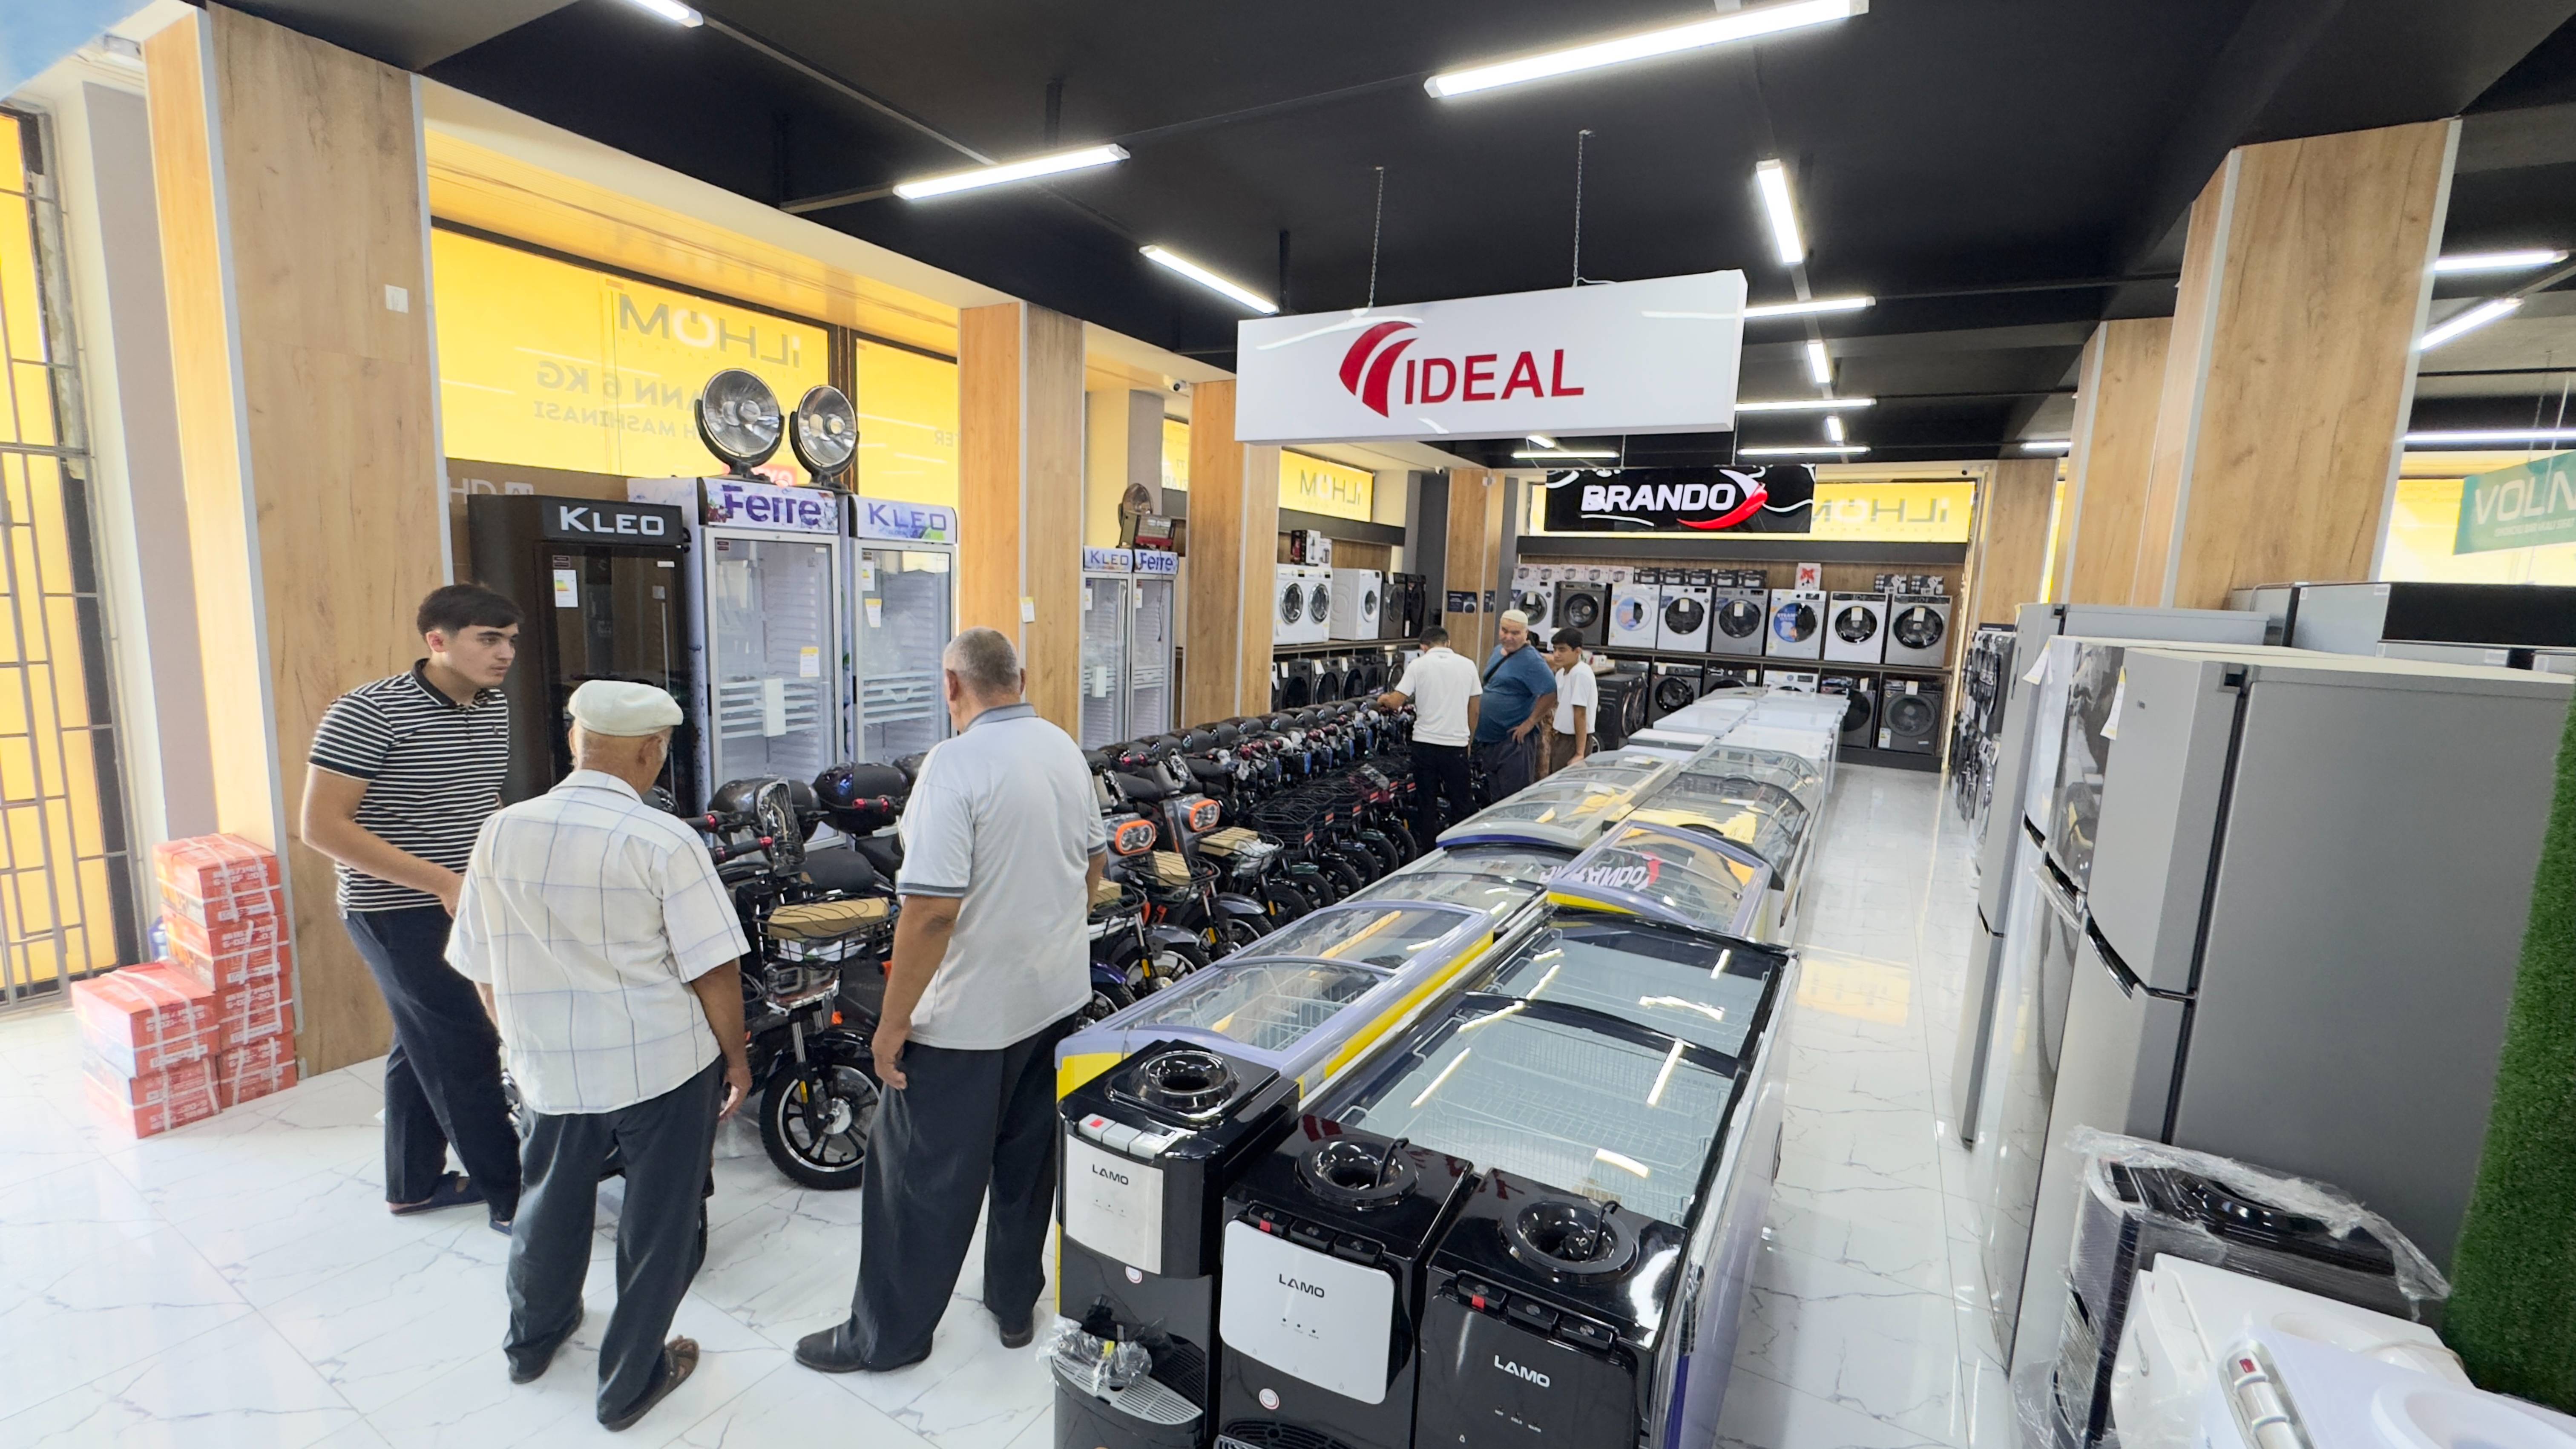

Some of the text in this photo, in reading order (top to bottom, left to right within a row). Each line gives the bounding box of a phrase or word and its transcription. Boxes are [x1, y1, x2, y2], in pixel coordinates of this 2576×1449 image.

[1404, 348, 1584, 405] IDEAL
[722, 484, 821, 526] Ferre
[1581, 483, 1736, 512] BRANDO
[559, 505, 665, 536] KLEO
[868, 503, 947, 531] KLEO
[1090, 550, 1129, 566] KLEO
[1140, 552, 1173, 571] Ferre
[1092, 1164, 1129, 1185] LAMO
[1279, 1273, 1325, 1298] LAMO
[1494, 1354, 1550, 1388] LAMO
